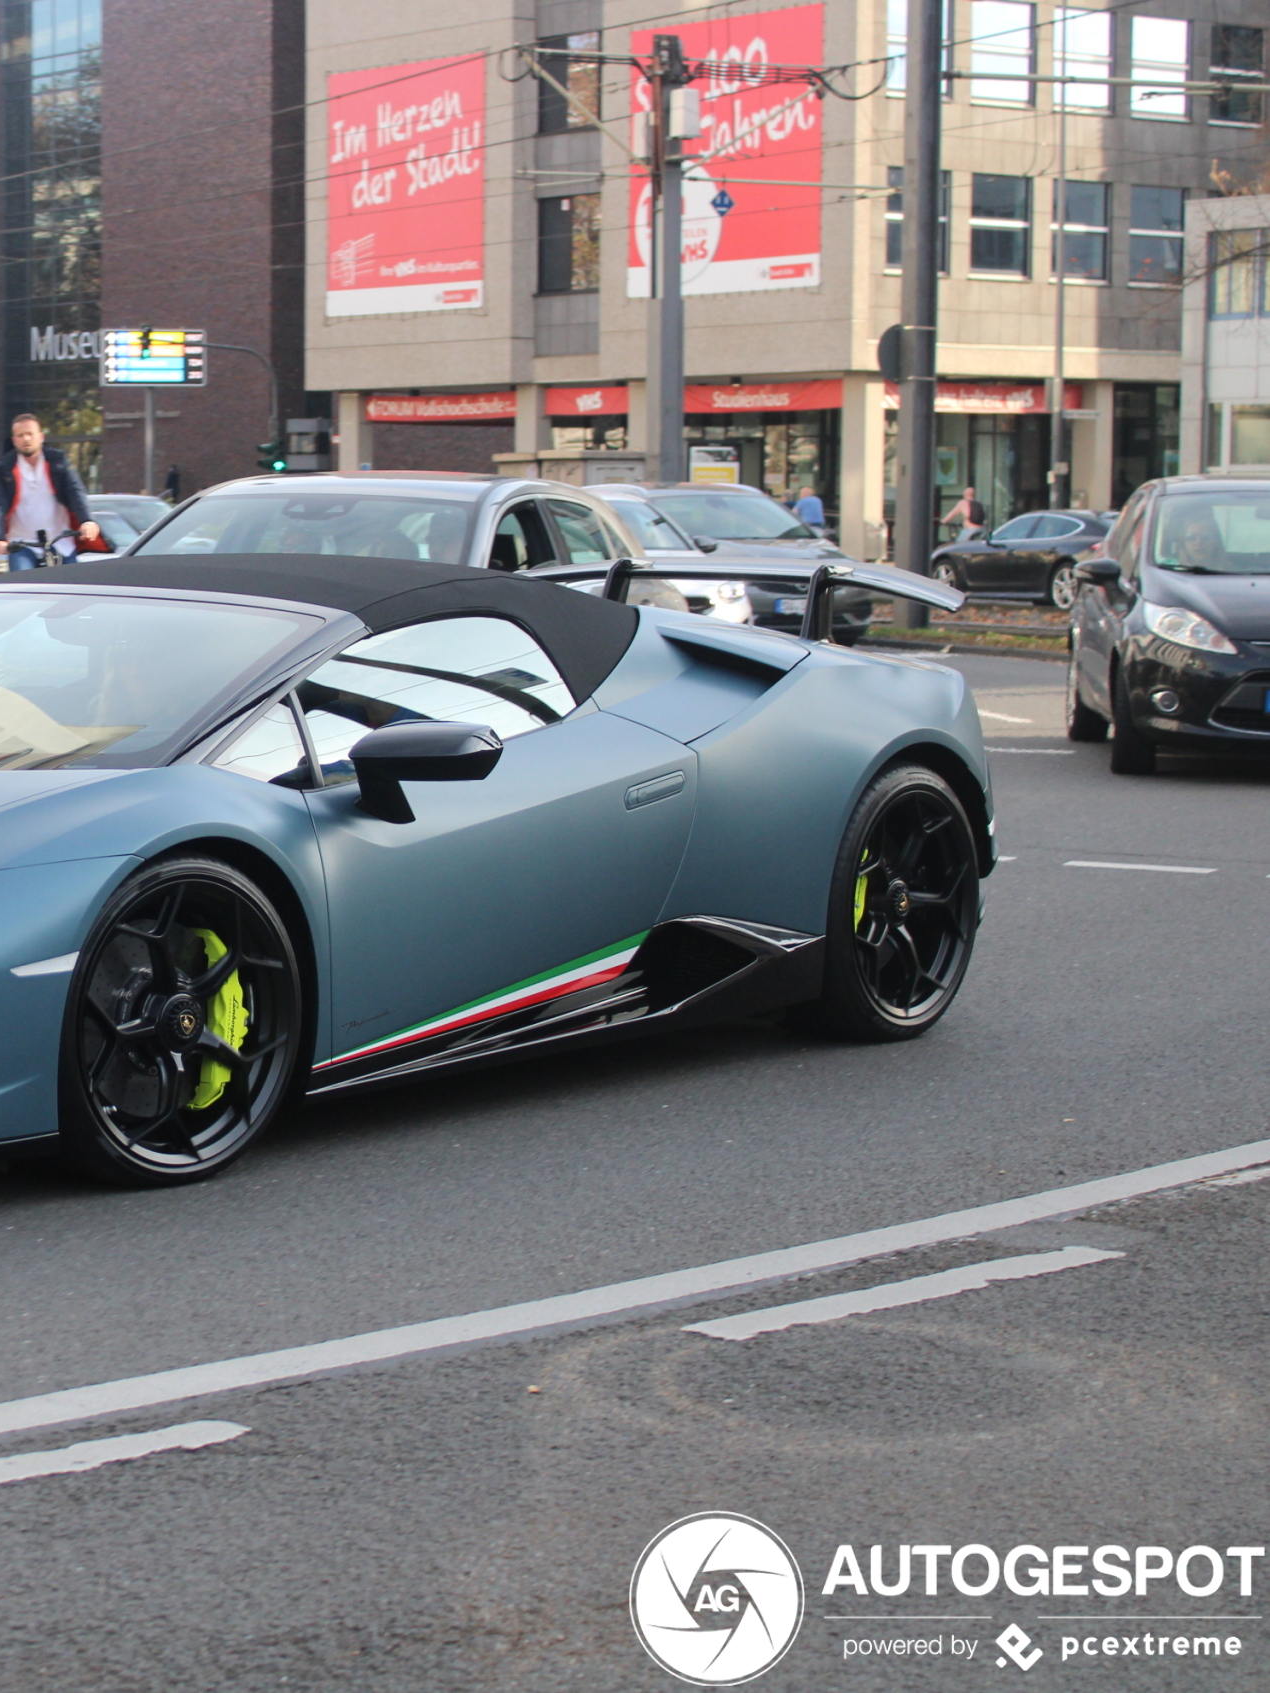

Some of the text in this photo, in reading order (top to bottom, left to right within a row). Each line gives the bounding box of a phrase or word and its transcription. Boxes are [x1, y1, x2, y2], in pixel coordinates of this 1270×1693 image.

[704, 37, 768, 102] 100
[331, 90, 464, 164] Im Herzen
[351, 120, 481, 209] der Stadt!
[30, 325, 102, 361] Museu
[376, 401, 415, 416] FORUM
[712, 390, 790, 409] Studienhaus
